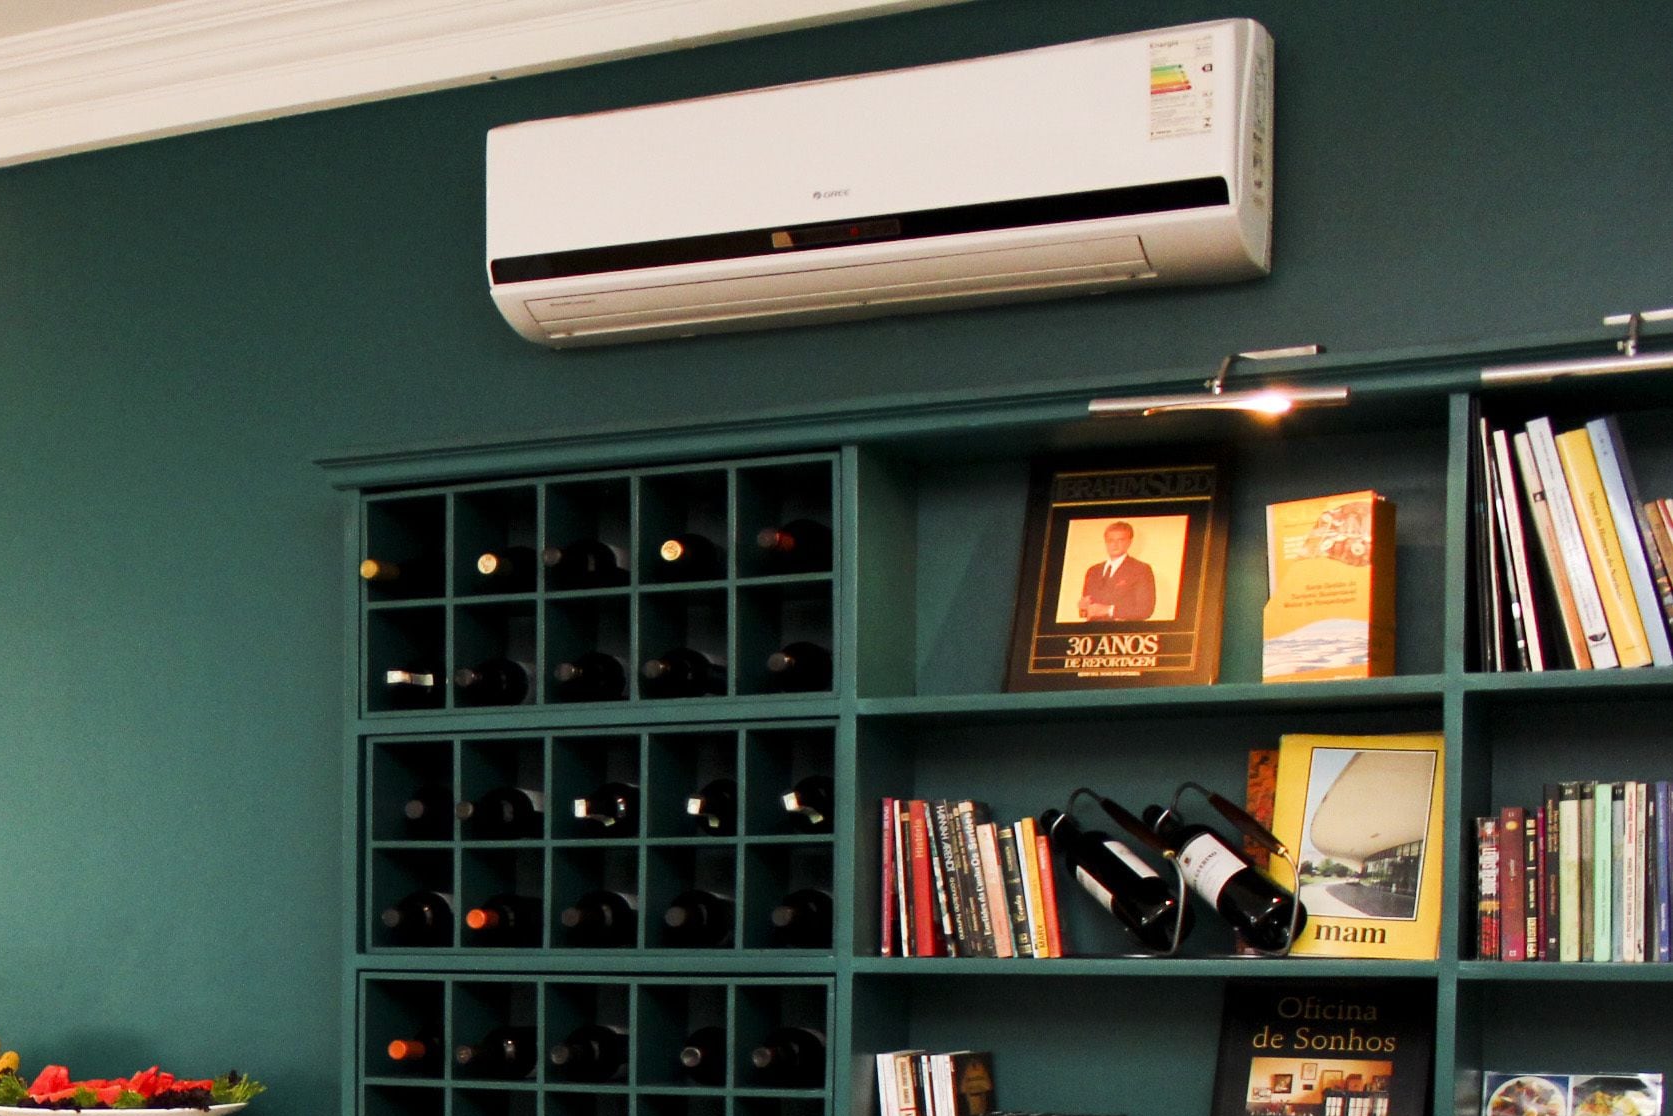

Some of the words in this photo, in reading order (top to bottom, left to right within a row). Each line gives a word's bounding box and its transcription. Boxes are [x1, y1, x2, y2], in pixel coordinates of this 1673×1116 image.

[1066, 637, 1092, 656] 30
[1094, 634, 1159, 655] ANOS
[1064, 657, 1081, 669] DE
[1081, 656, 1157, 668] REPORTAGEM
[935, 805, 949, 840] HANNAH
[963, 812, 977, 849] Sertões
[914, 818, 925, 858] História
[940, 840, 956, 872] ARENDT
[969, 852, 979, 866] Os
[977, 892, 985, 902] da
[1037, 924, 1045, 947] MARX
[1314, 922, 1387, 945] mam
[1278, 996, 1377, 1021] Oficina
[1252, 1025, 1286, 1049] de
[1294, 1027, 1397, 1052] Sonhos
